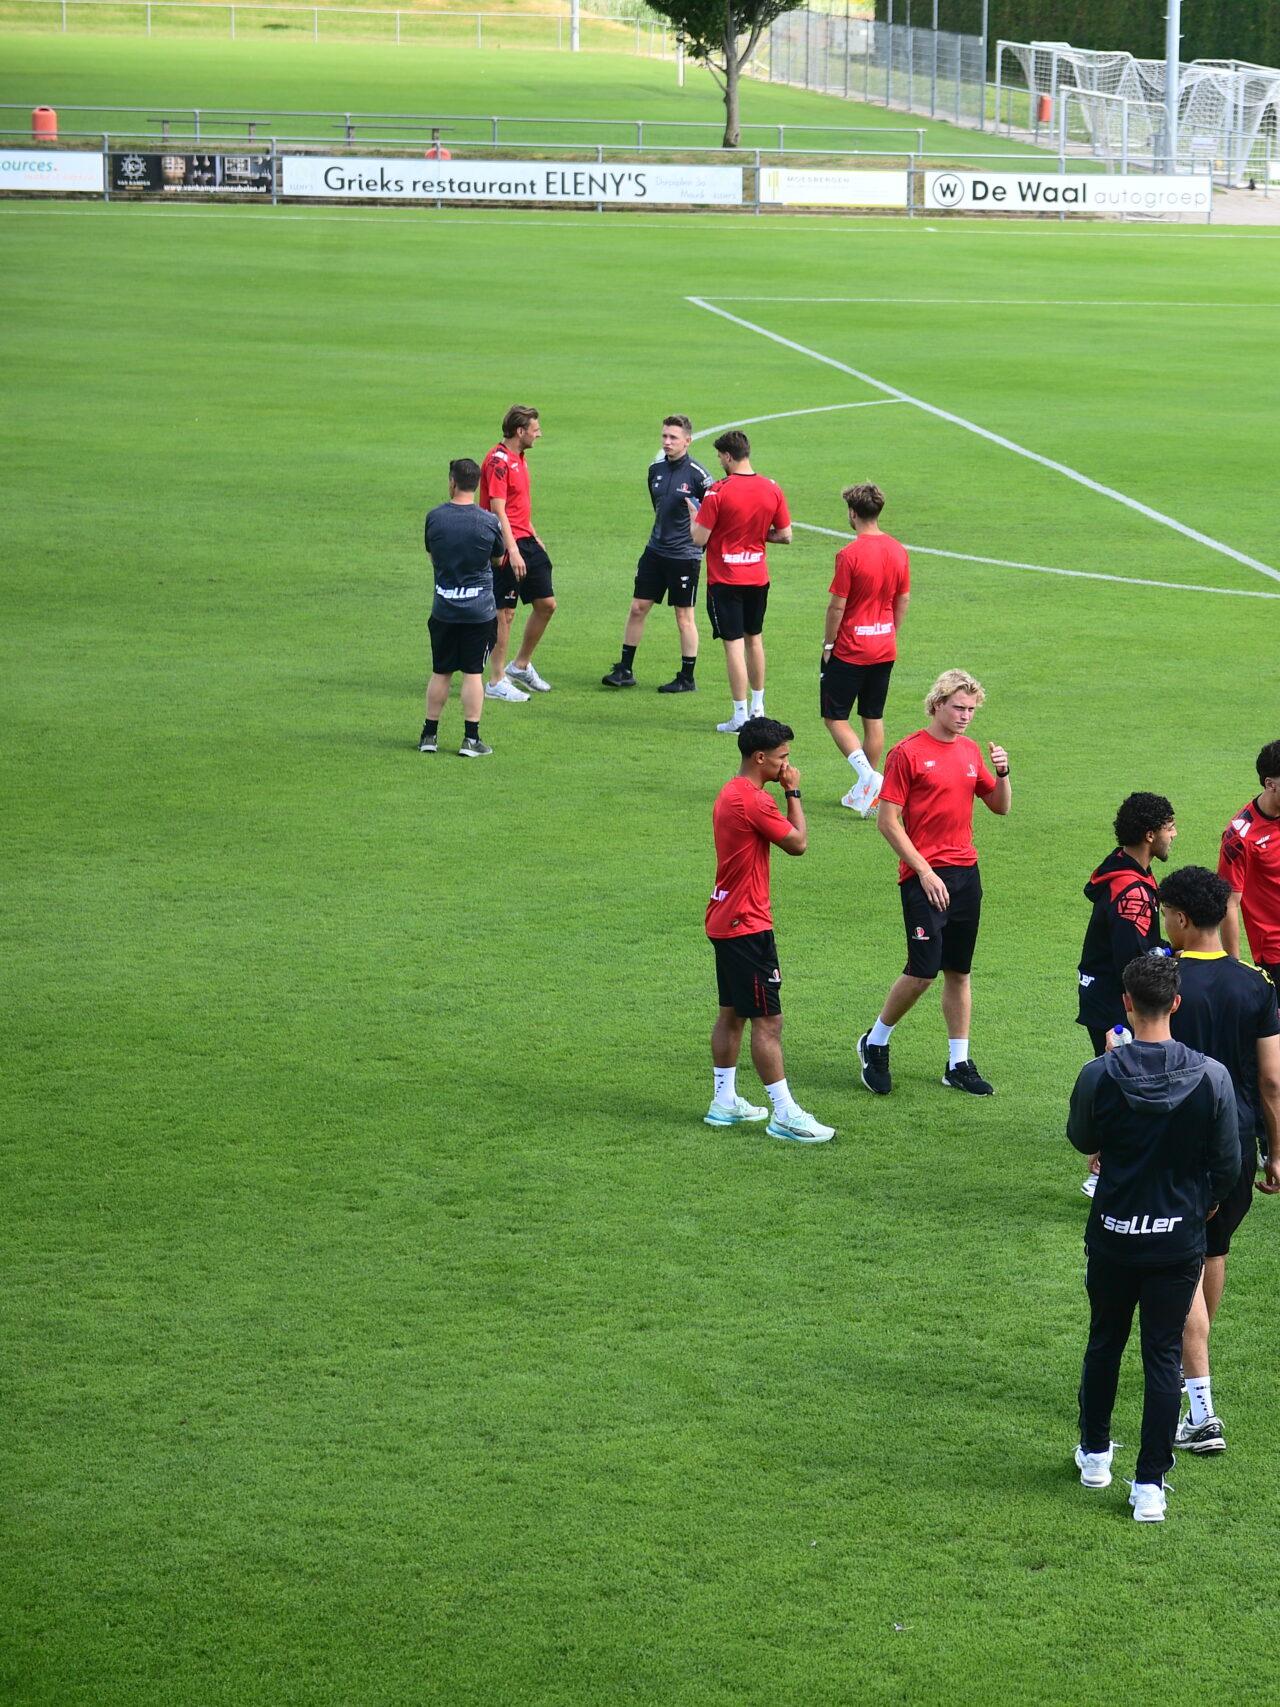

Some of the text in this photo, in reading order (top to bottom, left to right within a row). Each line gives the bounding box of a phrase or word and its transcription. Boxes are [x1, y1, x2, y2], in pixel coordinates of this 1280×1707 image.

[0, 160, 58, 172] ources.
[324, 166, 647, 197] Grieks restaurant ELENY'S
[972, 180, 1207, 208] De Waal autogroep
[1100, 1214, 1183, 1235] saller
